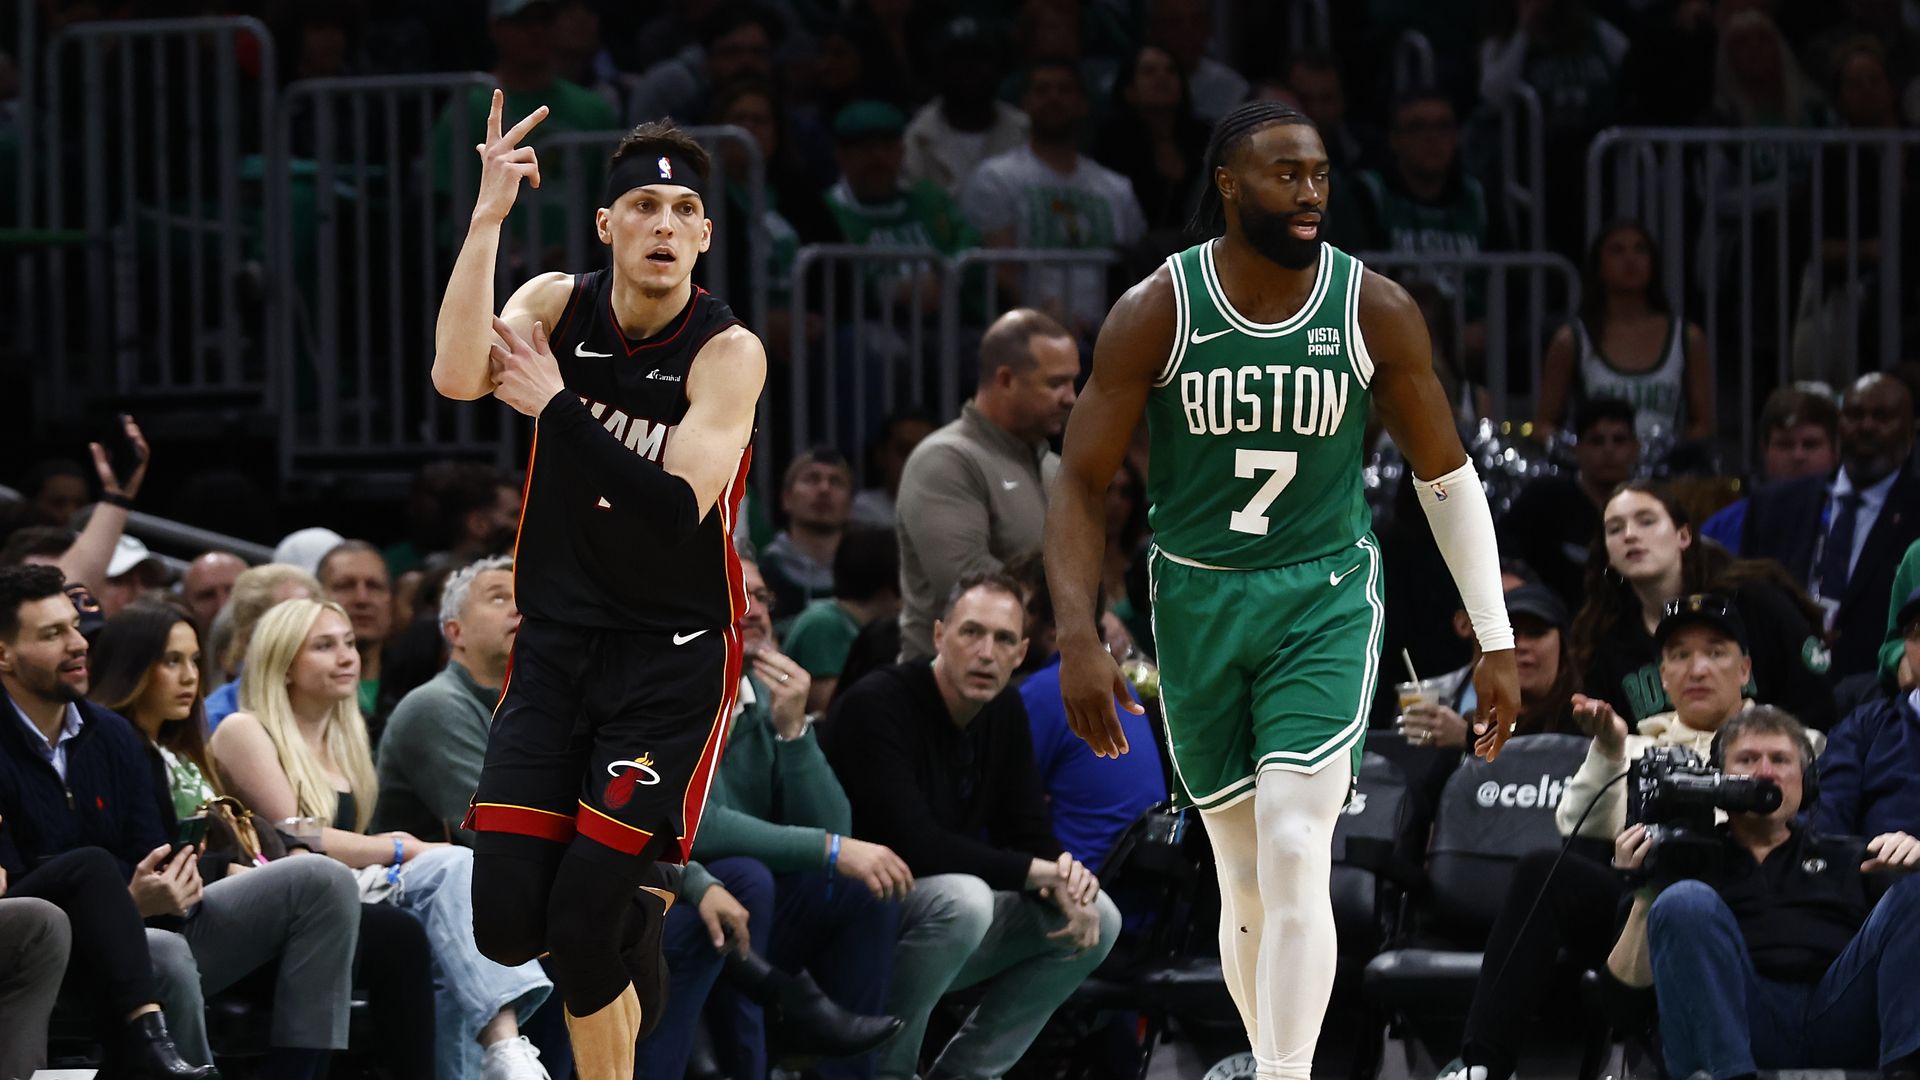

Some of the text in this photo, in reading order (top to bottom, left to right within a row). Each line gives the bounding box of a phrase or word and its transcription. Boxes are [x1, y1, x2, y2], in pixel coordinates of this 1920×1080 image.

[1307, 327, 1340, 344] VISTA
[1308, 344, 1340, 356] PRINT
[655, 373, 681, 382] Carnival
[1180, 365, 1349, 437] BOSTON
[1229, 448, 1298, 536] 7
